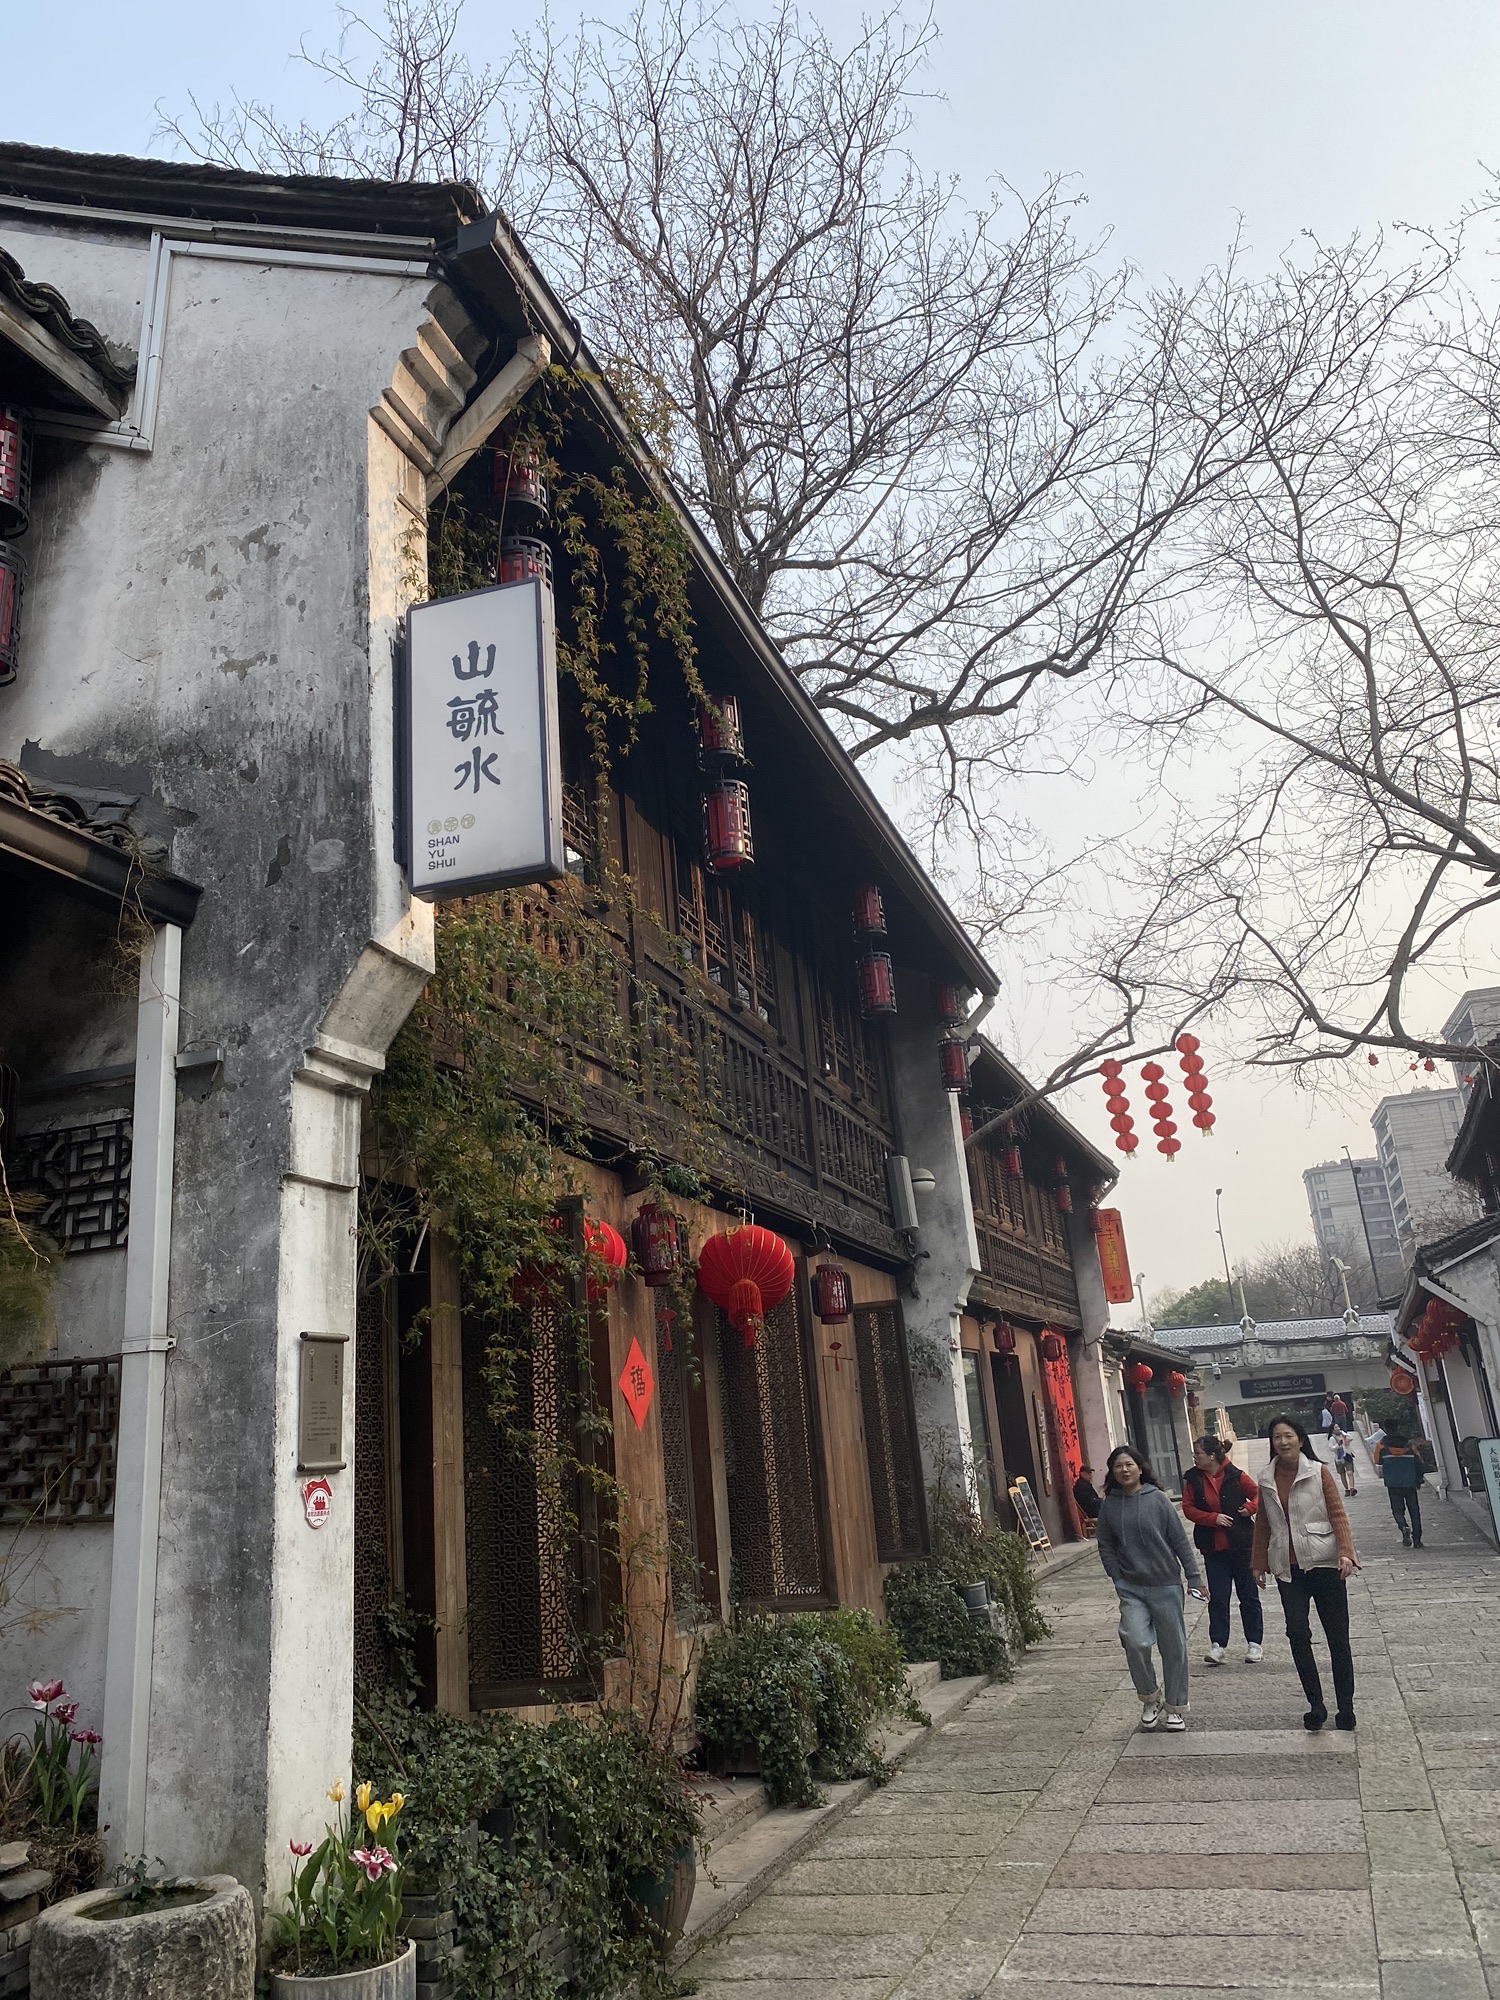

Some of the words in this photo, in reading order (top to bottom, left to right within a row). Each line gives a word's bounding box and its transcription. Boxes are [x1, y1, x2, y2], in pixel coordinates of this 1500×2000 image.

[446, 640, 504, 794] 山毓水
[428, 834, 460, 848] SHAN
[428, 848, 445, 859] YU
[428, 857, 456, 870] SHUI
[630, 1365, 646, 1400] 福
